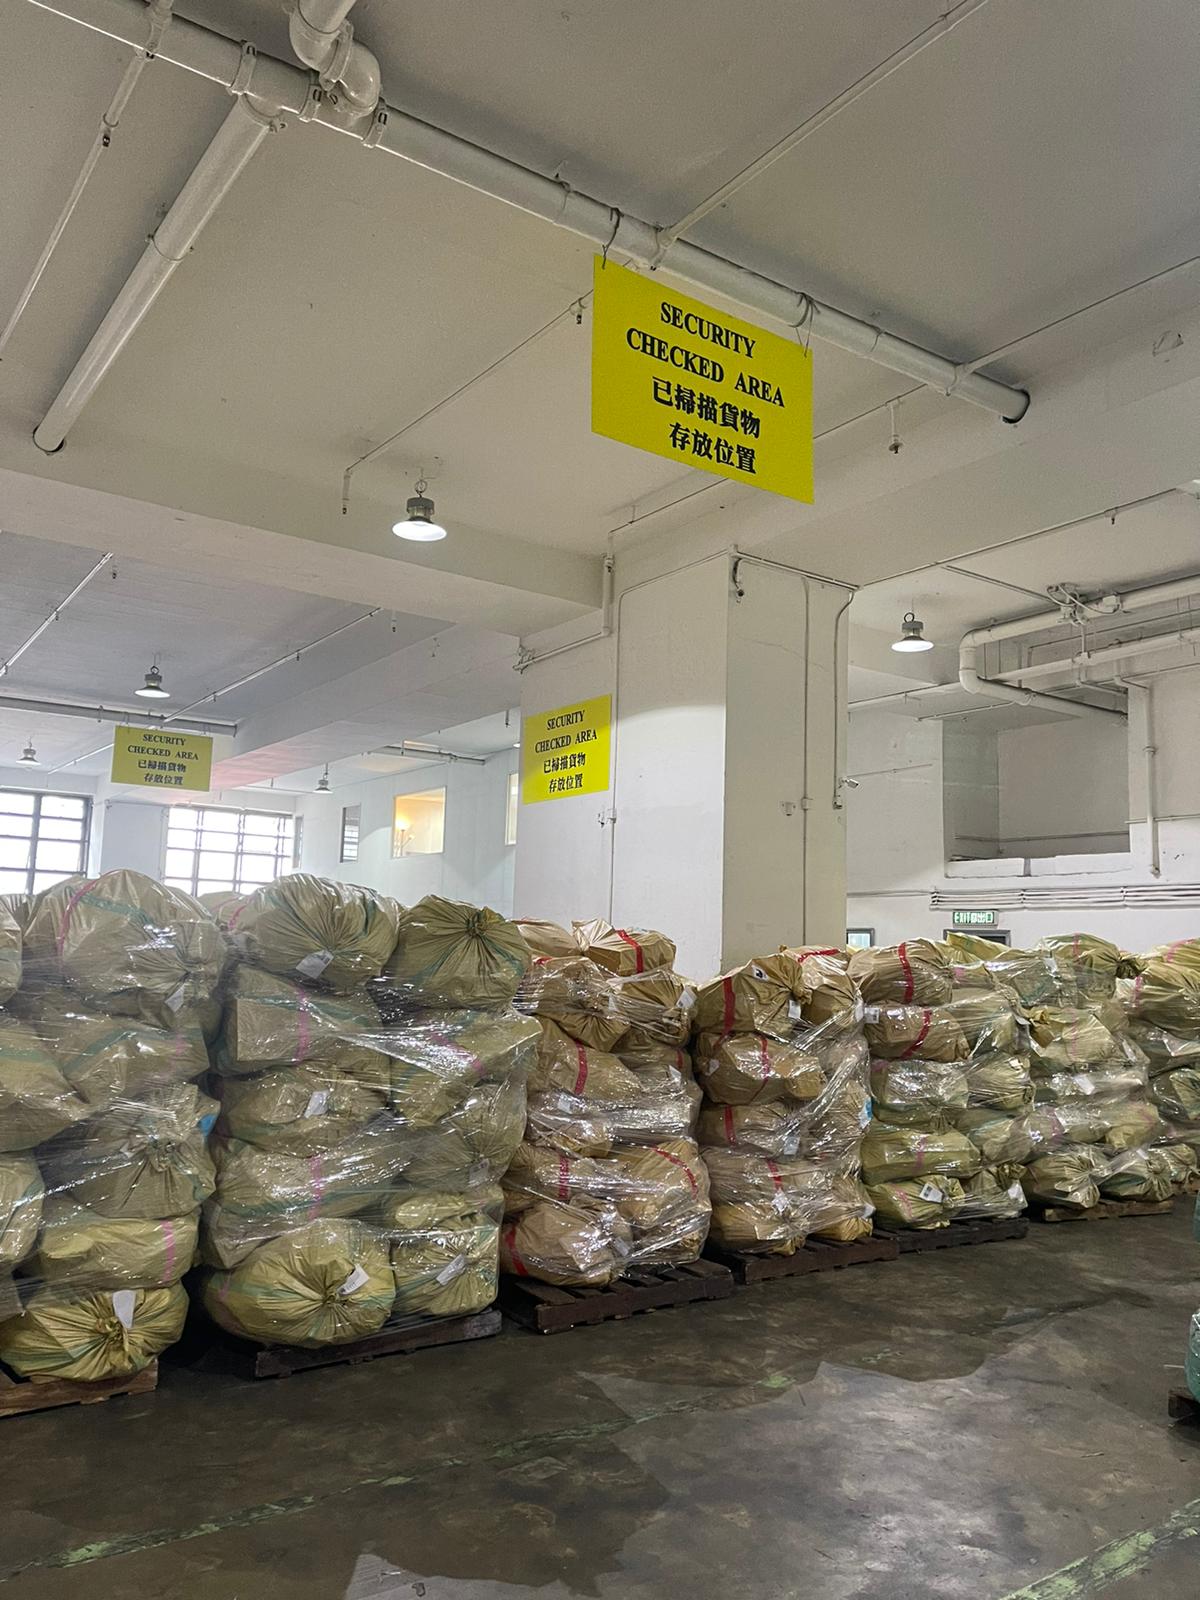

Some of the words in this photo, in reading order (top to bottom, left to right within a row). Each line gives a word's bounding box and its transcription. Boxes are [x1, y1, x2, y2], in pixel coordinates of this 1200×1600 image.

[660, 301, 756, 358] SECURITY
[626, 327, 724, 383] CHECKED
[734, 372, 785, 408] AREA
[652, 376, 761, 439] 已掃描貨物
[669, 422, 756, 474] 存放位置
[547, 710, 585, 730] SECURITY
[143, 734, 186, 746] SECURITY
[535, 735, 572, 753] CHECKED
[575, 729, 597, 744] AREA
[128, 745, 170, 757] CHECKED
[175, 752, 198, 760] AREA
[543, 751, 586, 774] 已掃描貨物
[549, 773, 583, 793] 存放位置
[954, 911, 971, 923] EXIT
